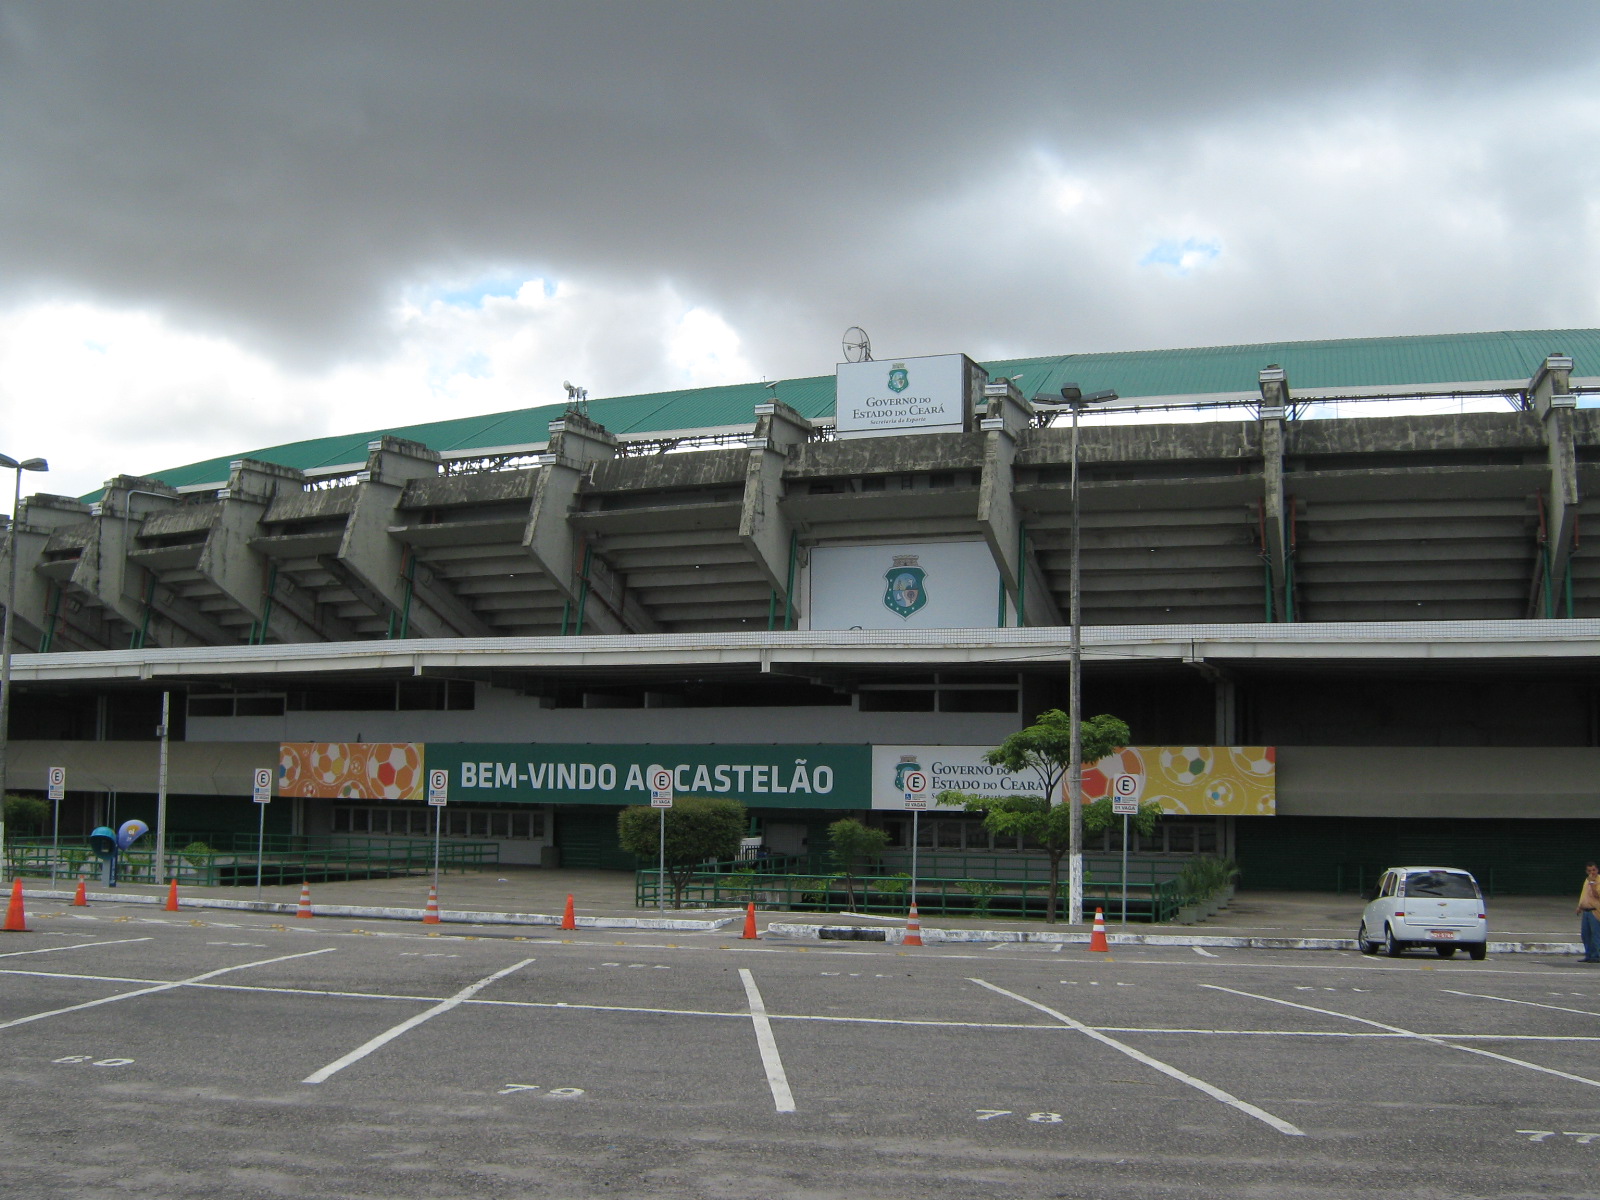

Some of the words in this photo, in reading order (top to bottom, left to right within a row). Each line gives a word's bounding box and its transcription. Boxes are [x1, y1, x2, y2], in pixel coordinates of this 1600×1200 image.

[55, 772, 60, 781] E
[261, 774, 266, 783] E
[436, 775, 441, 785] E
[461, 762, 617, 790] BEM-VINDO
[674, 758, 834, 794] CASTELÃO
[659, 775, 665, 786] E
[912, 777, 920, 788] E
[1122, 780, 1130, 791] E
[497, 1083, 585, 1097] 79
[975, 1109, 1064, 1123] 78
[1515, 1129, 1600, 1144] 77
